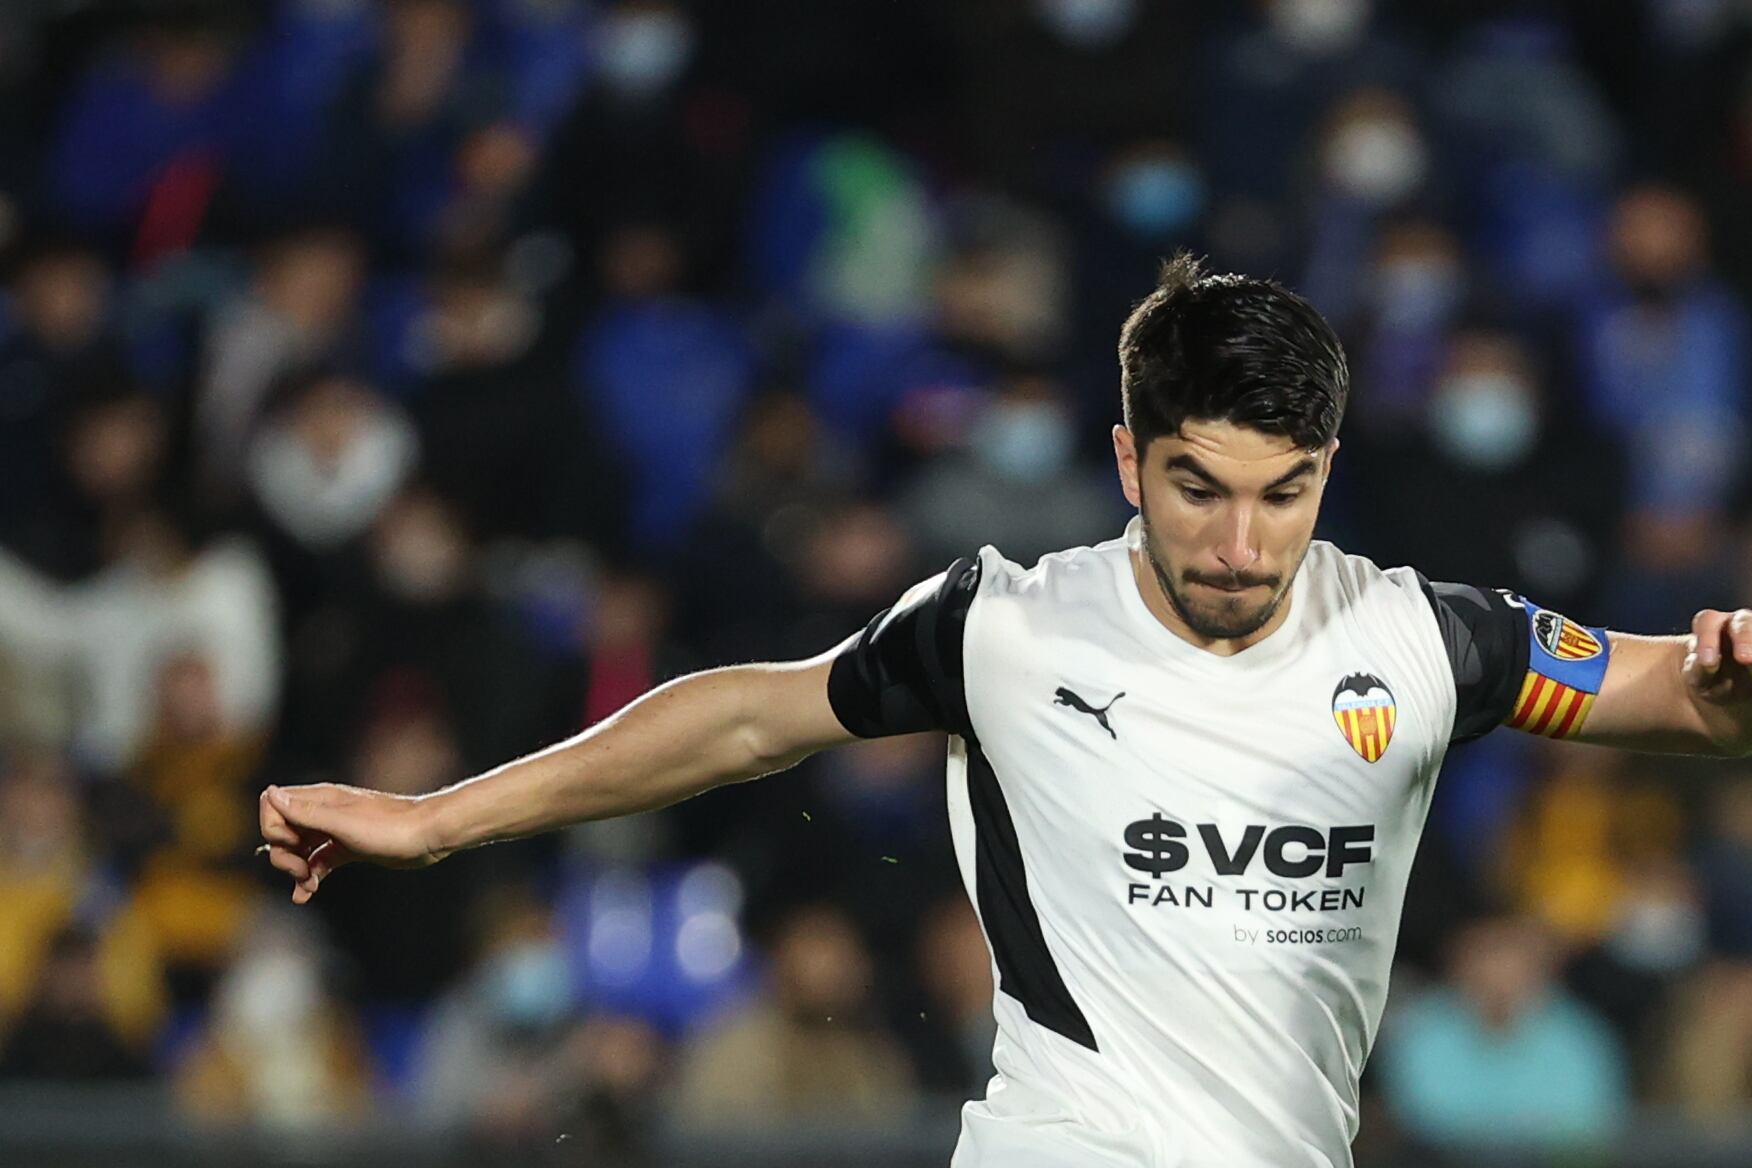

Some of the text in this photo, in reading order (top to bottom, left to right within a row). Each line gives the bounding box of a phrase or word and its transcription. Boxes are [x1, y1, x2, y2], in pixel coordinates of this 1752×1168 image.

[1128, 883, 1365, 912] FAN TOKEN
[1234, 923, 1260, 945] by
